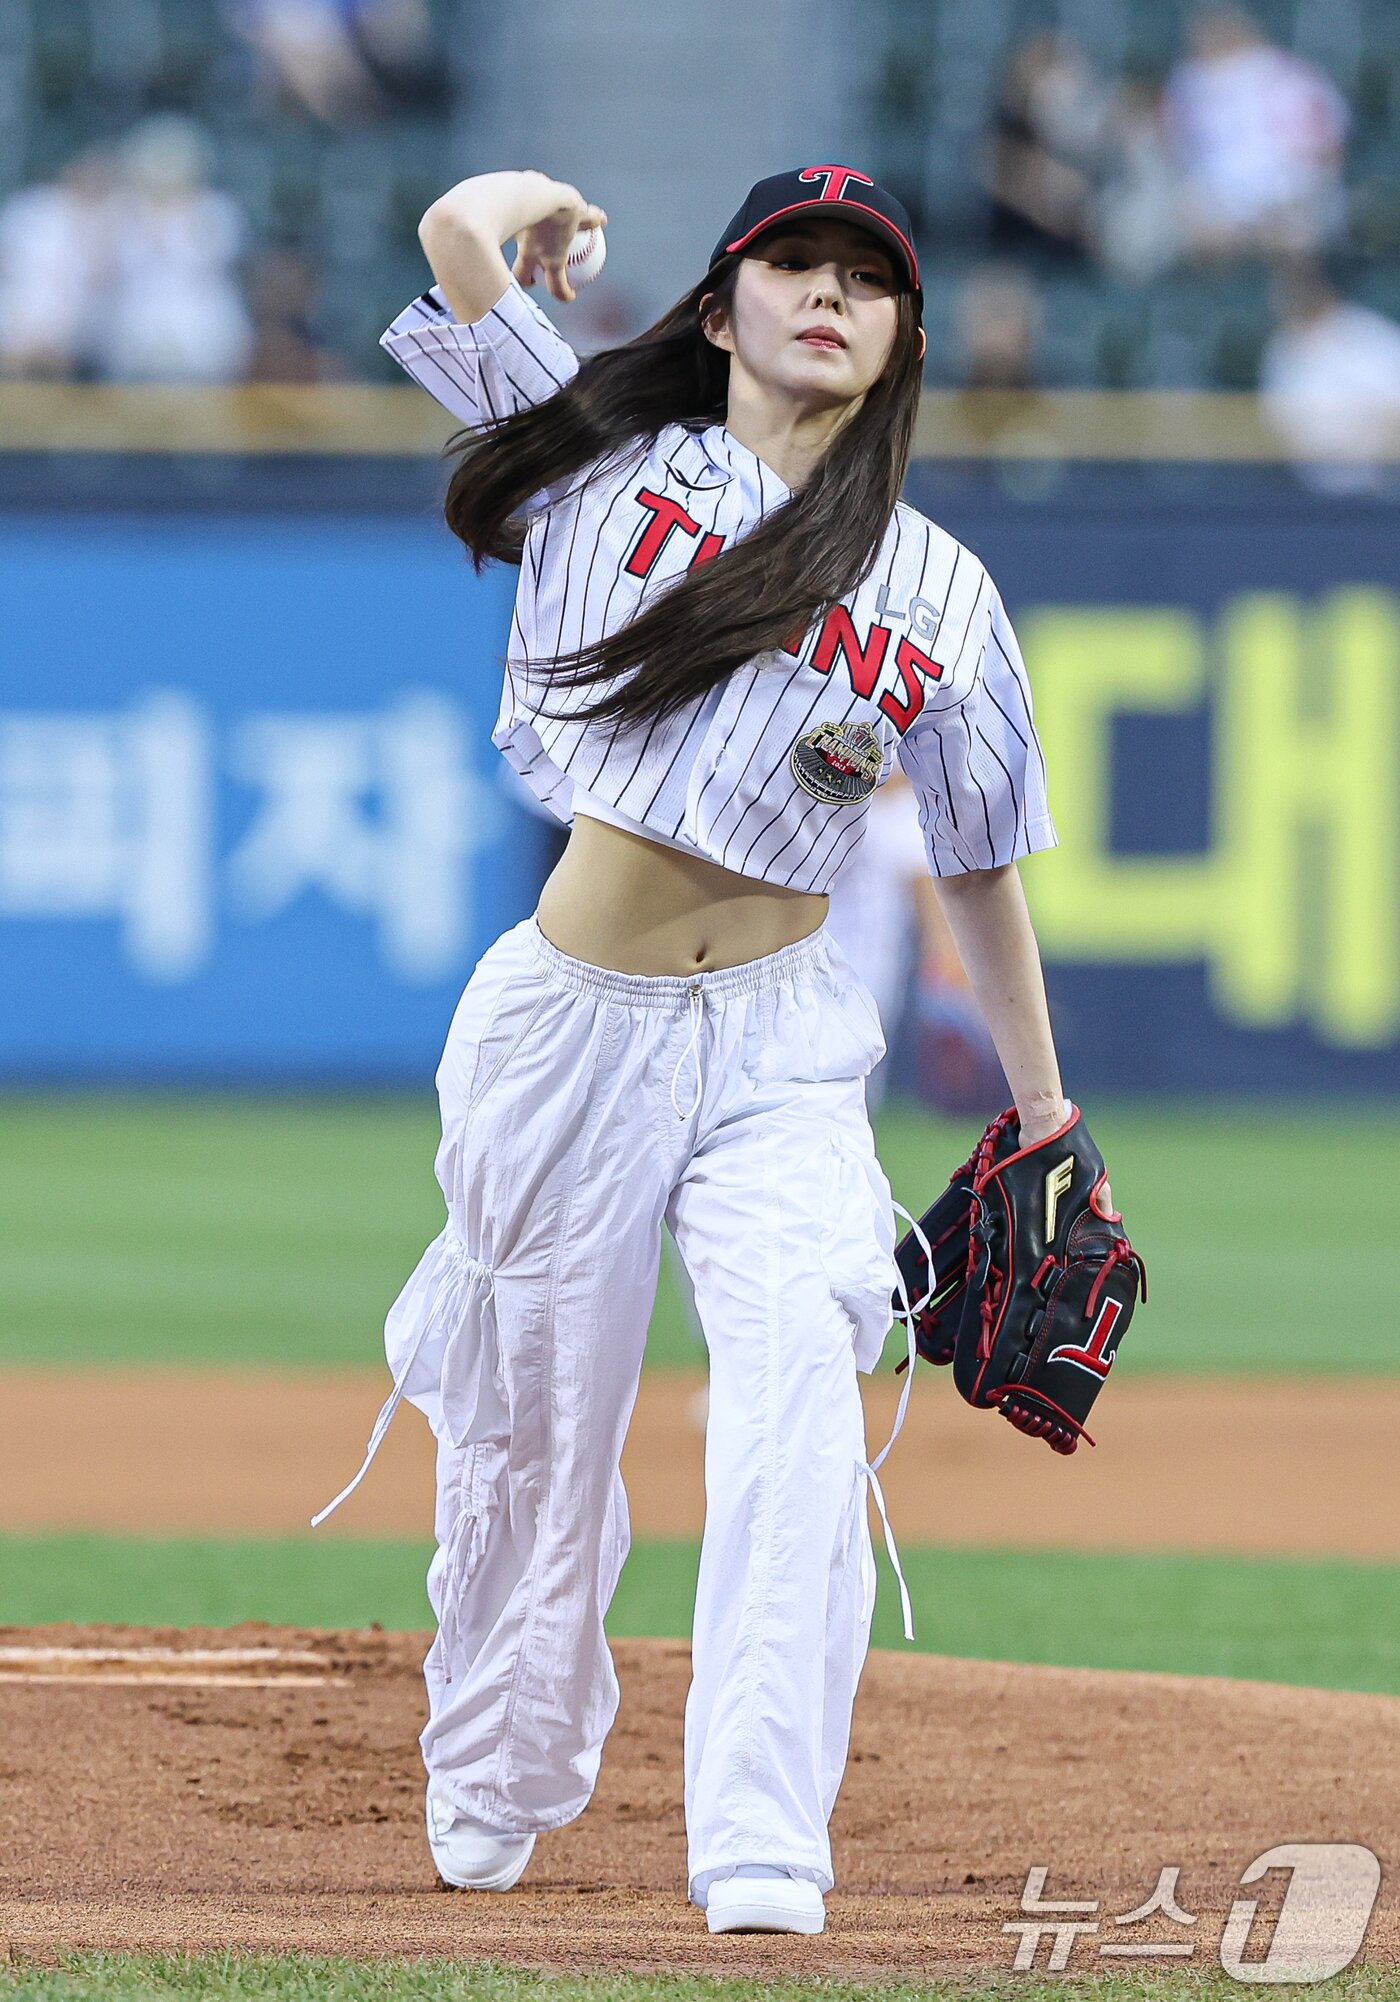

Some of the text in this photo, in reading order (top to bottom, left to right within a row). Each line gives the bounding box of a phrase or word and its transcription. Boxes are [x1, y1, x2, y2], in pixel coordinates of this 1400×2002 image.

[799, 163, 874, 200] T
[624, 486, 944, 735] TNS
[875, 583, 940, 640] LG
[805, 730, 879, 783] CHAMPIONS
[1023, 592, 1400, 1042] 대
[1045, 1154, 1075, 1244] F
[1047, 1296, 1123, 1381] T
